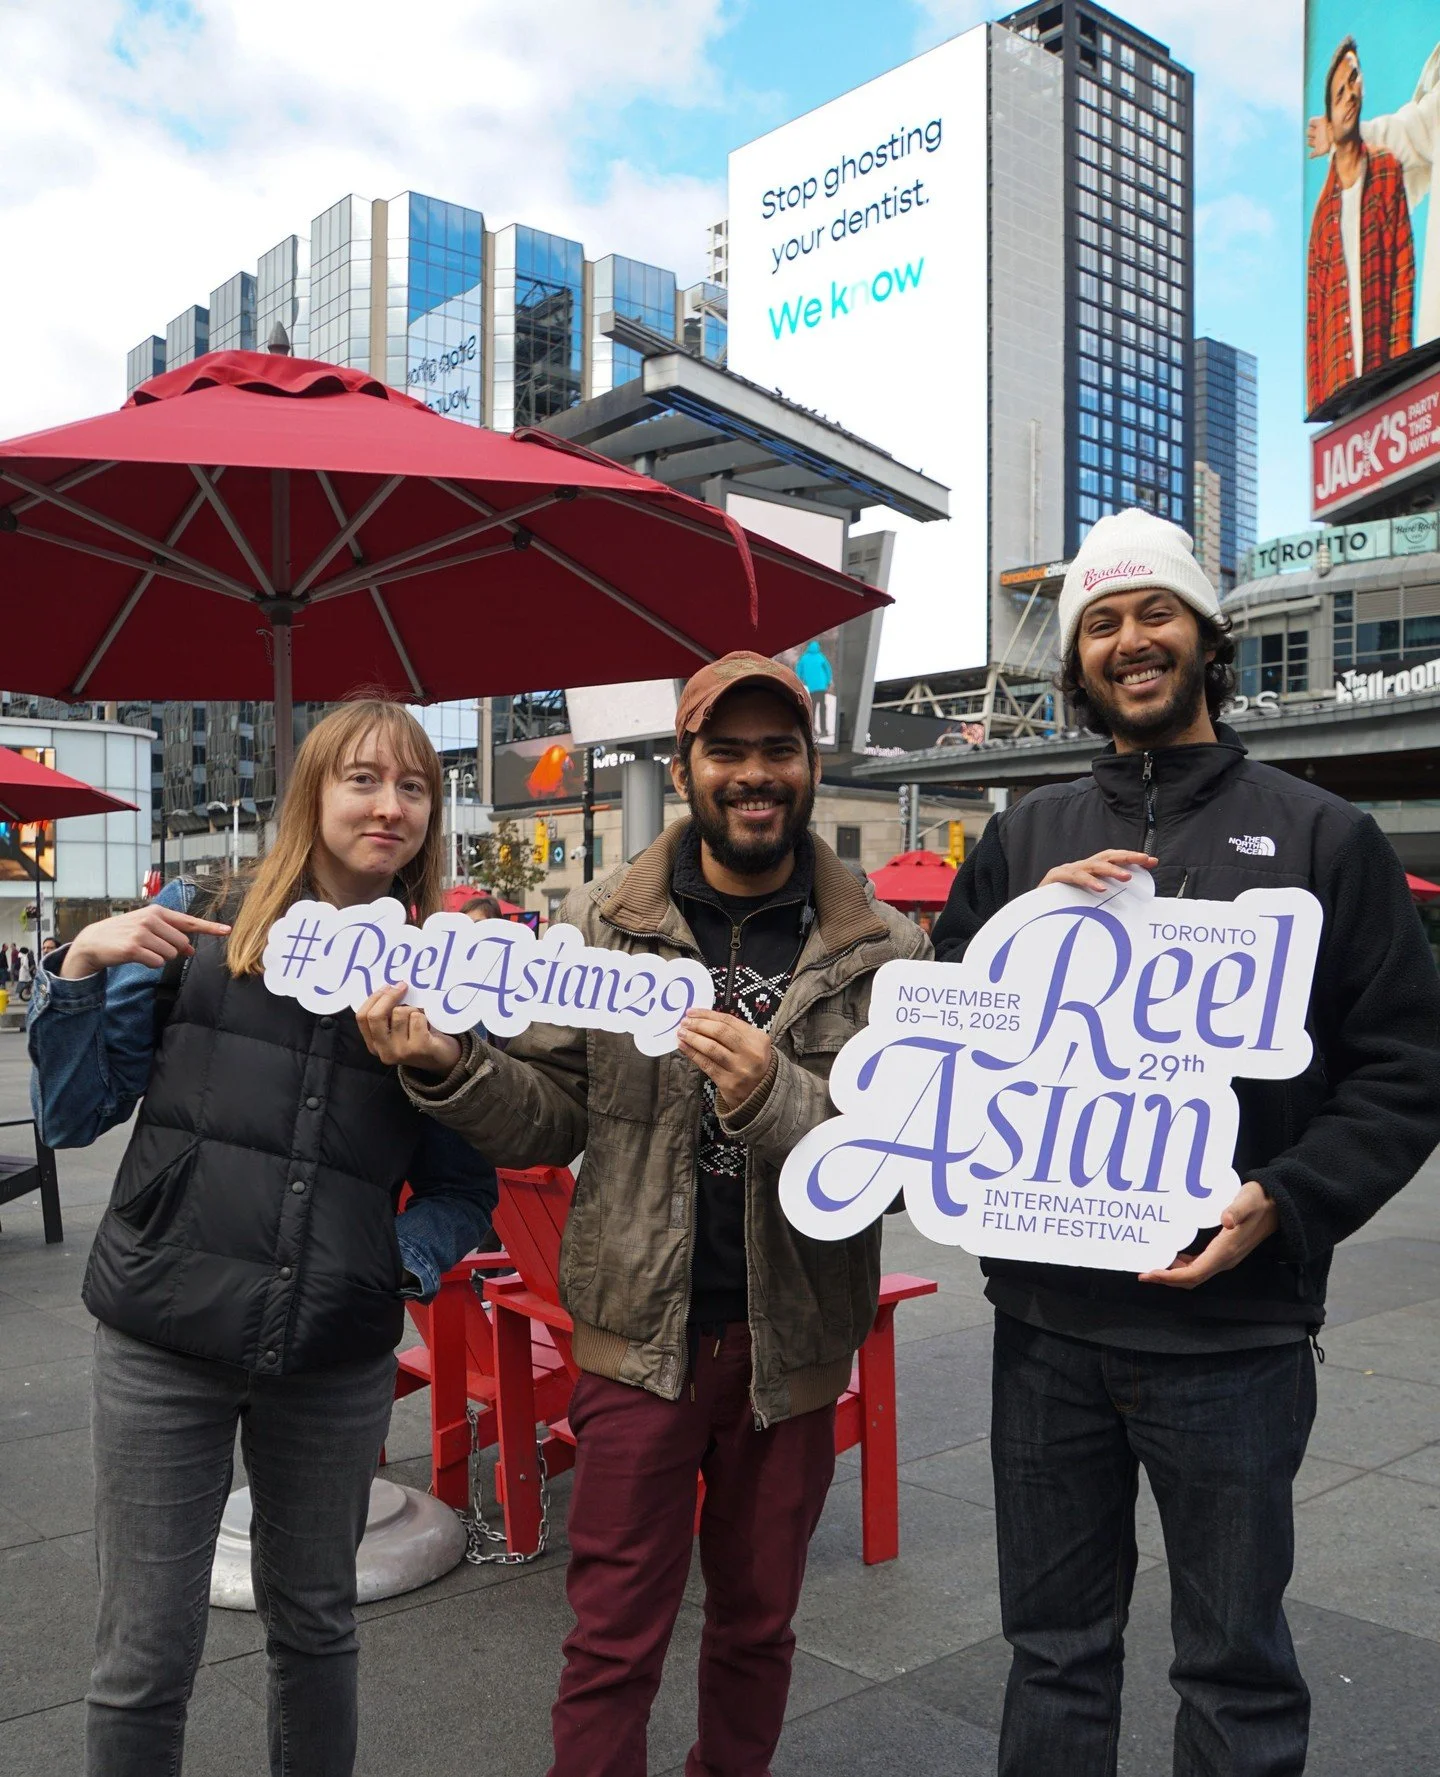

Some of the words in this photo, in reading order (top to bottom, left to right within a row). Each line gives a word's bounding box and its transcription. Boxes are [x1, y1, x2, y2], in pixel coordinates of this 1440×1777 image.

[762, 177, 817, 219] Stop
[824, 117, 942, 198] ghosting
[771, 226, 825, 274] your
[831, 179, 930, 241] dentist.
[768, 295, 823, 340] We
[831, 257, 925, 319] know
[1408, 413, 1433, 438] THIS
[1316, 410, 1408, 500] JACK'S
[1083, 560, 1148, 588] Brooklyn
[1341, 669, 1368, 691] The
[1227, 836, 1261, 850] NORTH
[1235, 845, 1259, 856] FACE
[1243, 834, 1262, 844] THE
[1148, 923, 1257, 946] TORONTO
[898, 985, 1021, 1010] NOVEMBER
[971, 888, 1295, 1081] Reel
[969, 1012, 1021, 1032] 2025
[1138, 1053, 1205, 1083] 29th
[984, 1189, 1171, 1223] INTERNATIONAL
[982, 1211, 1038, 1233] FILM
[1044, 1217, 1151, 1244] FESTIVAL
